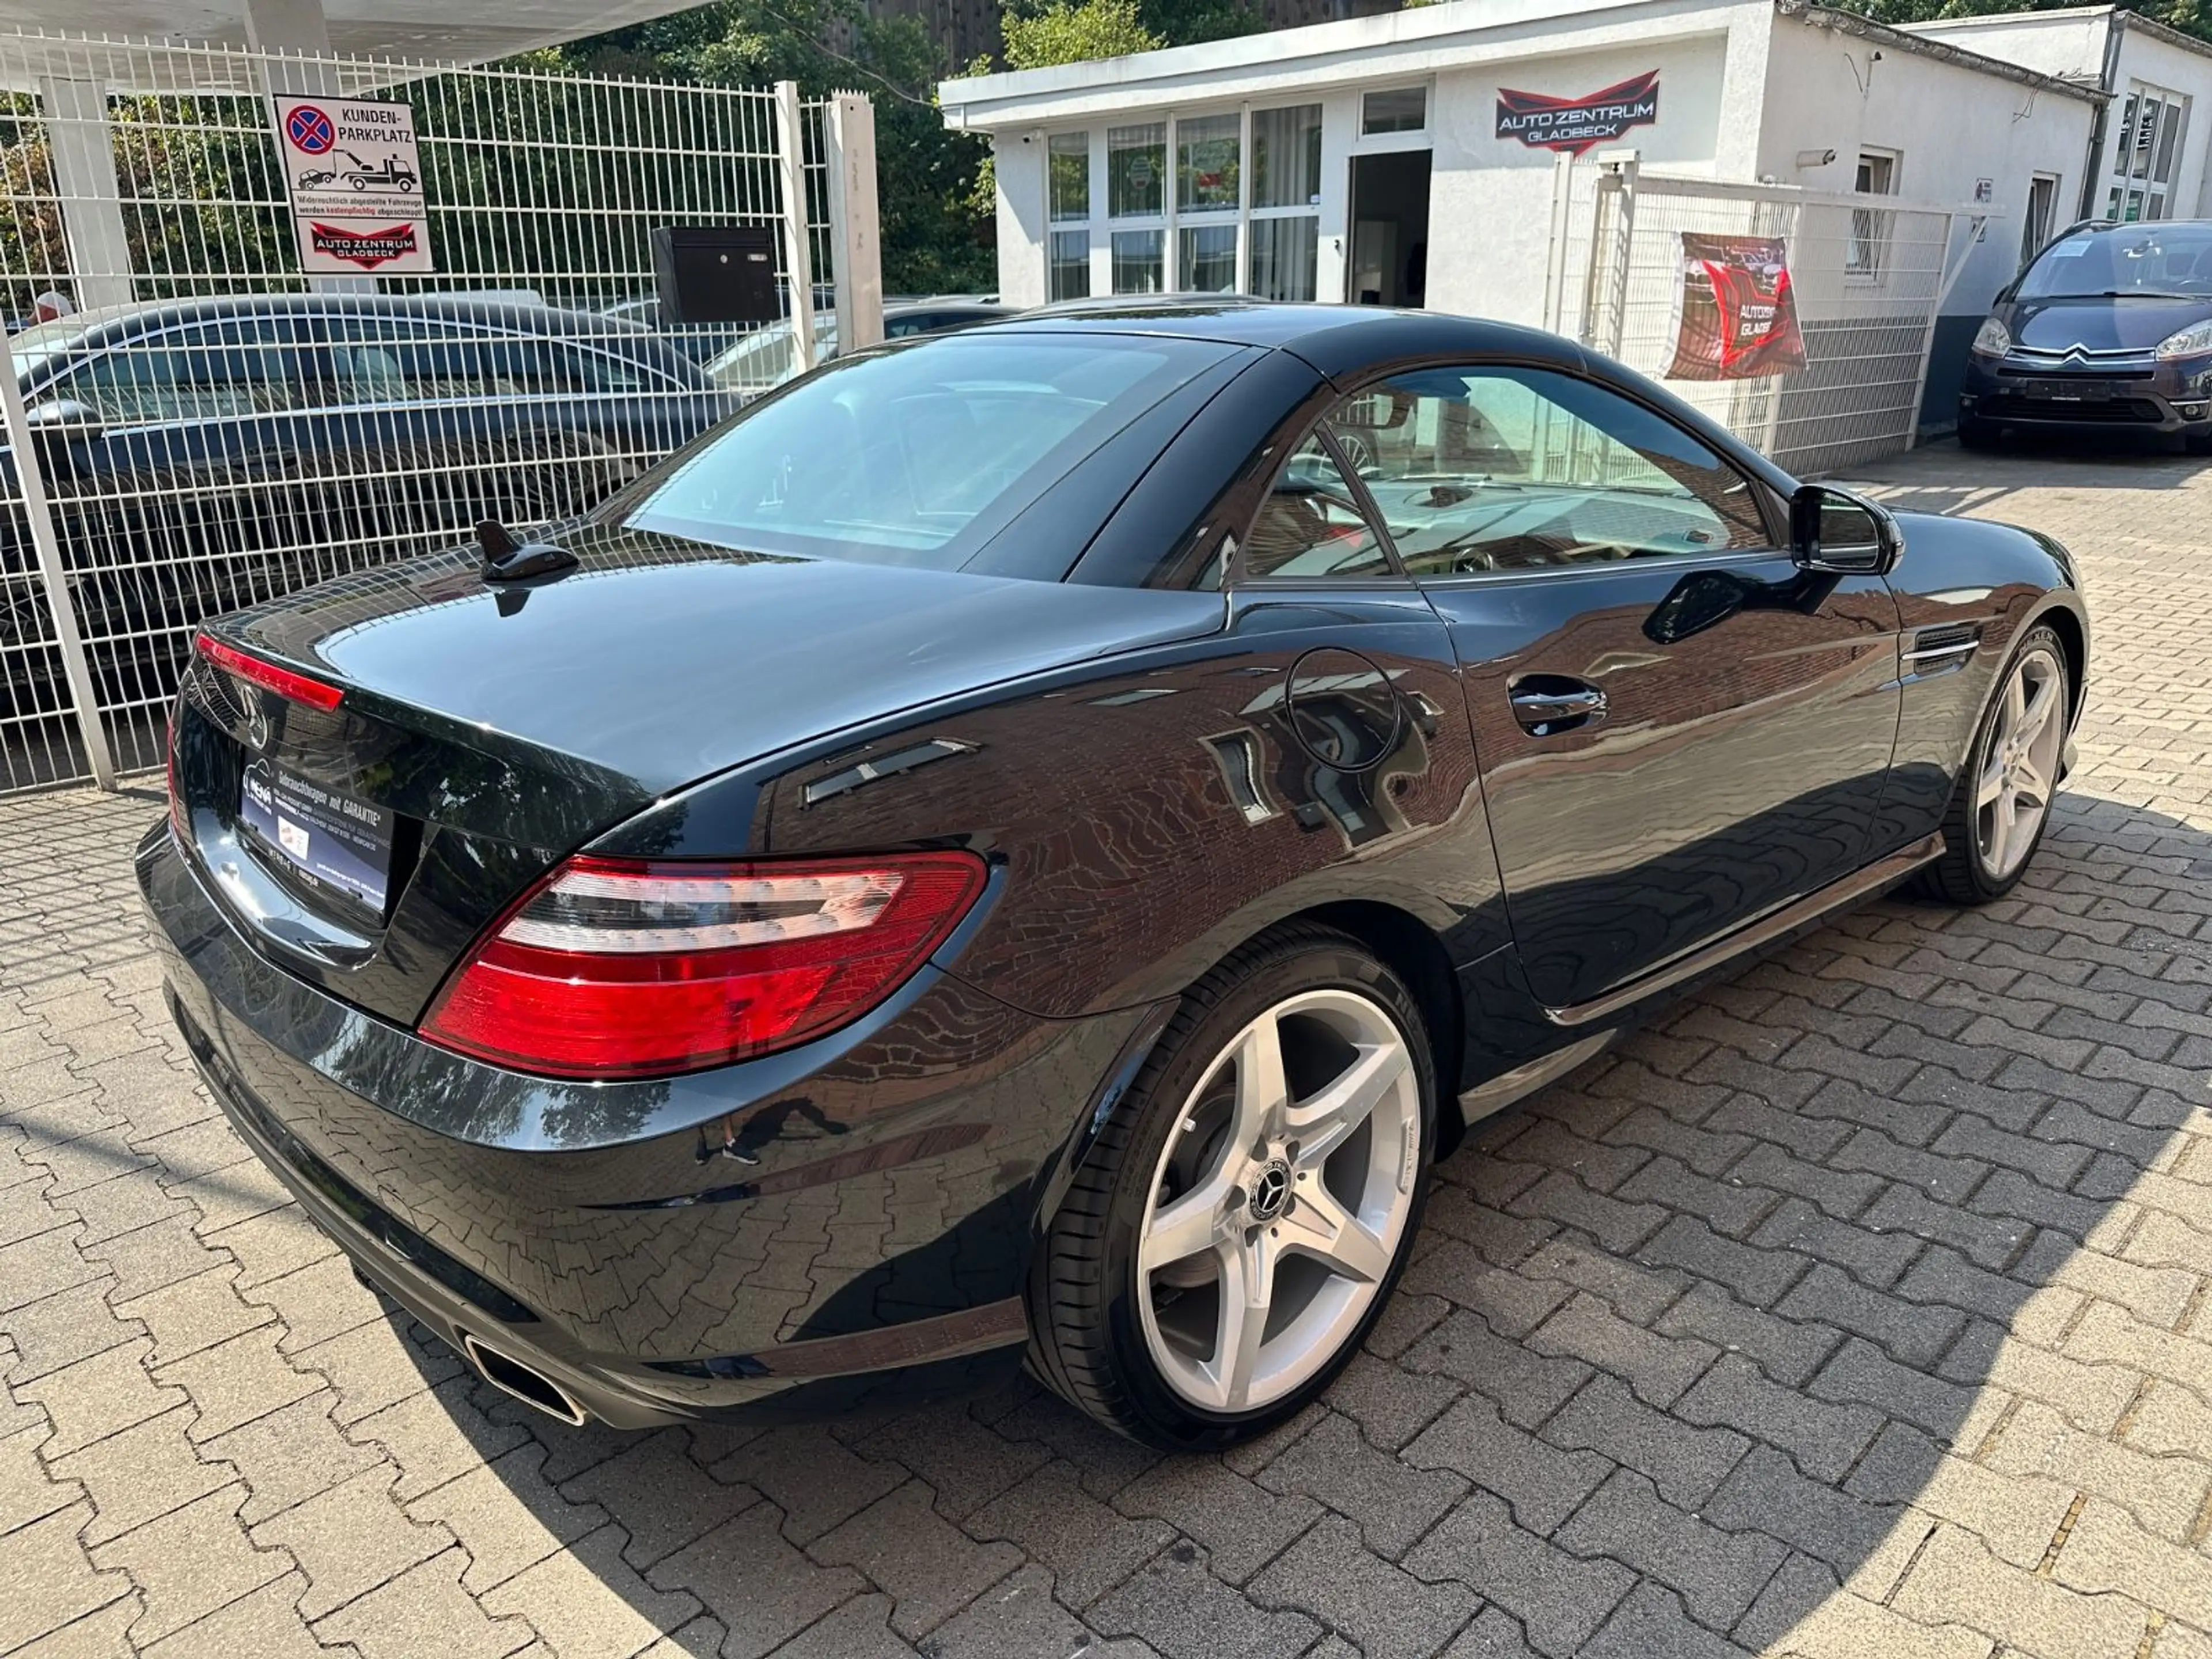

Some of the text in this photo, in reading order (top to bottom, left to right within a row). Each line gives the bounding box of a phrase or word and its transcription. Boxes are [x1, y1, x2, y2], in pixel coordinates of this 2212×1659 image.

[342, 108, 402, 124] KUNDEN-
[1498, 101, 1654, 131] AUTO ZENTRUM
[338, 126, 412, 143] PARKPLATZ
[1527, 123, 1618, 143] GLADBECK
[297, 195, 422, 207] Widerrechtlich abgestellte Fahrzeuge
[299, 206, 325, 214] werden
[326, 206, 376, 215] kostenpflichtig
[316, 238, 414, 248] AUTO ZENTRUM
[337, 249, 395, 257] GLADBECK
